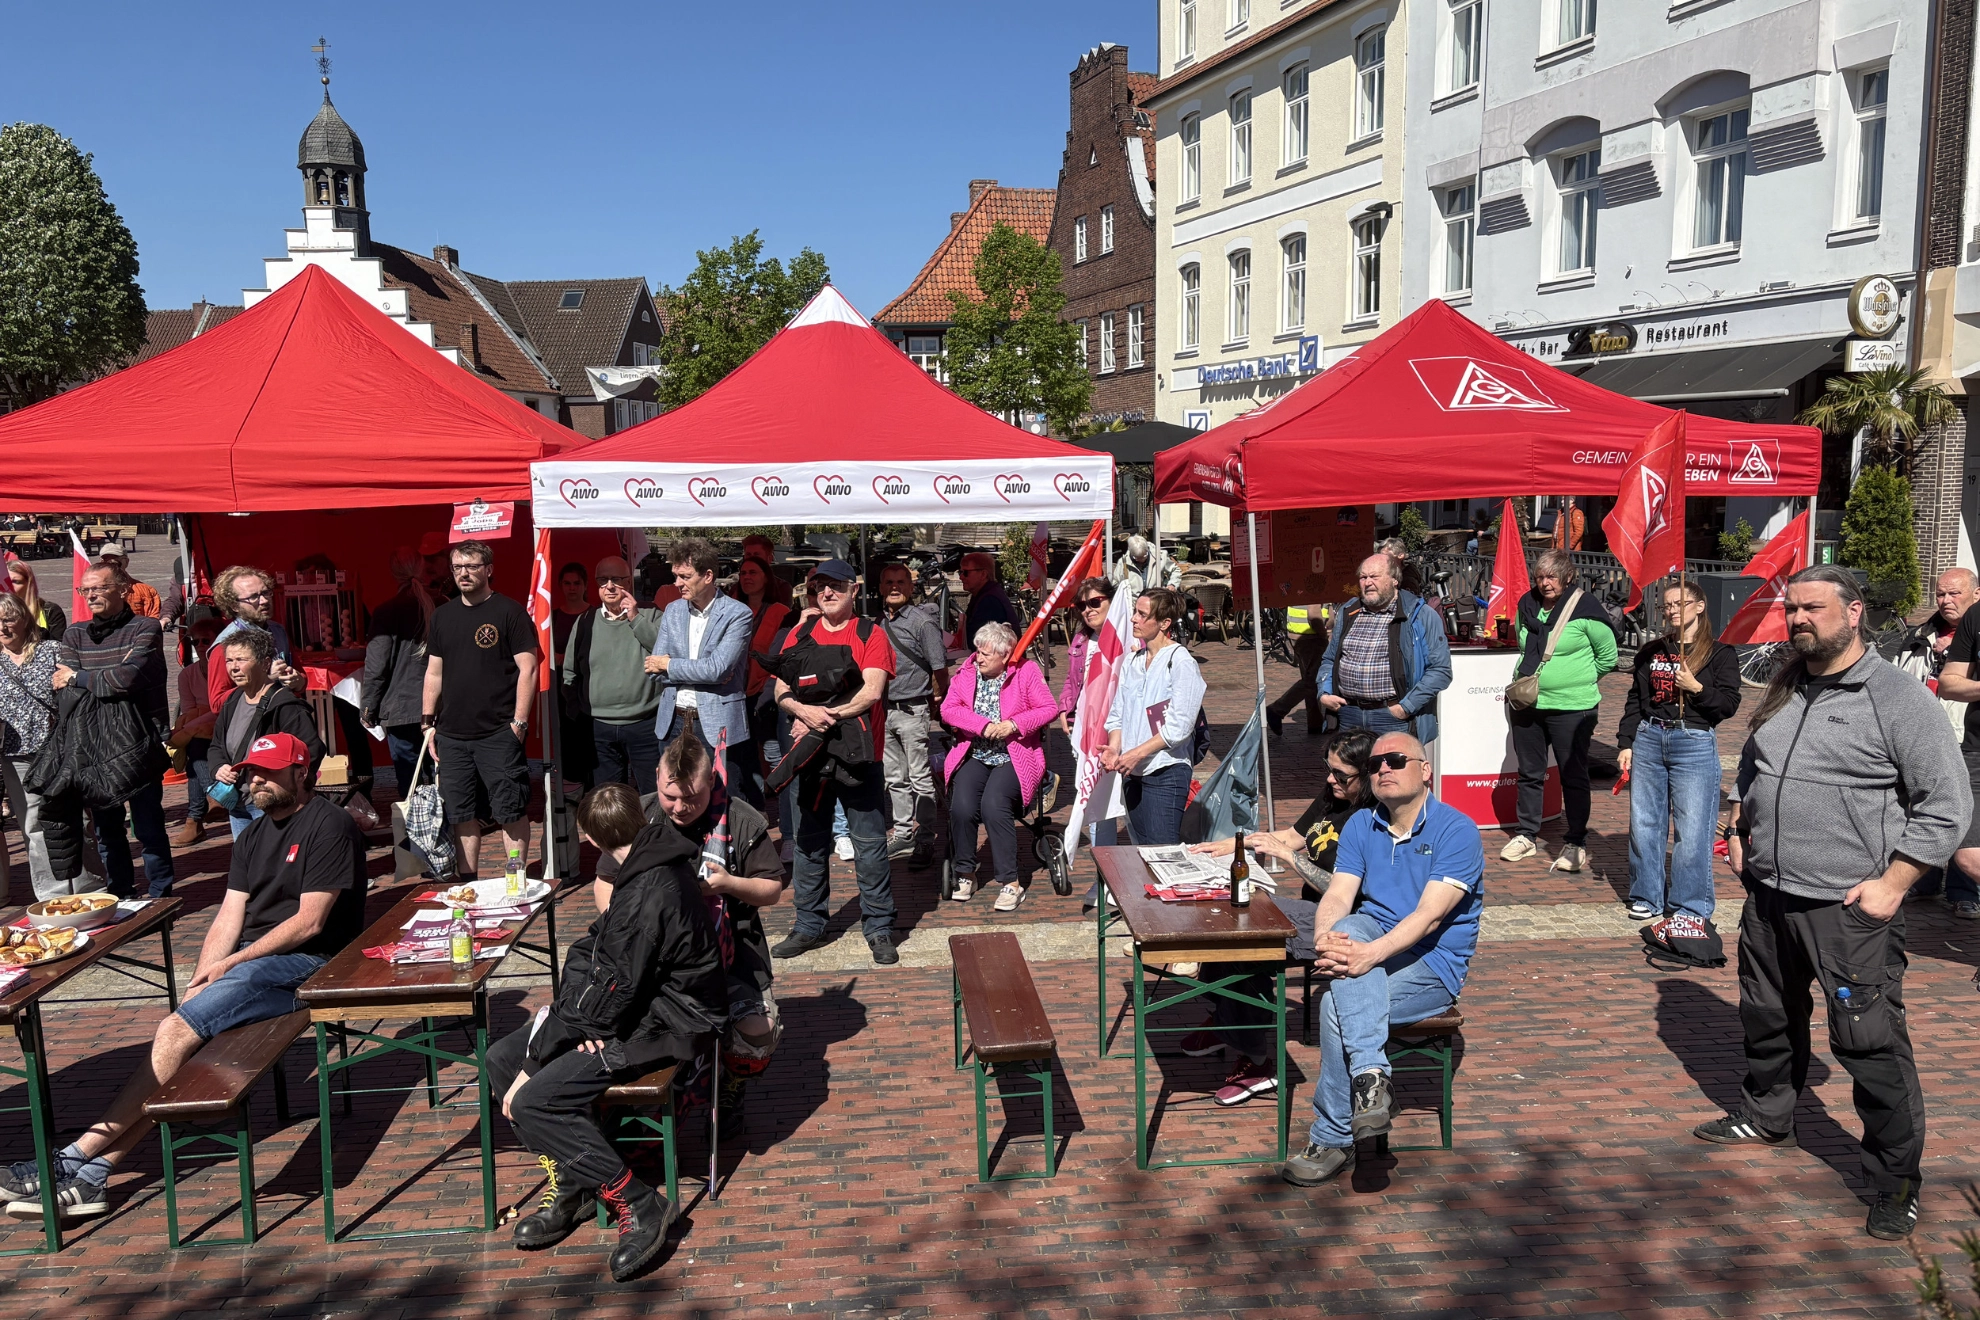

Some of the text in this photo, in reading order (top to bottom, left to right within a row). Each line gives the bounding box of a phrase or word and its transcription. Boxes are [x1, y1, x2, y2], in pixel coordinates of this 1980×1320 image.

[1540, 341, 1559, 356] Bar
[1647, 320, 1729, 344] Restaurant
[1198, 354, 1297, 384] Deutsche Bank
[1572, 450, 1632, 464] GEMEIN
[1699, 453, 1722, 466] EIN
[636, 487, 664, 498] AWO
[699, 486, 727, 497] AWO
[762, 485, 790, 497] AWO
[824, 484, 852, 496] AWO
[883, 484, 911, 495] AWO
[944, 481, 971, 495] AWO
[1004, 480, 1031, 494] AWO
[1064, 479, 1090, 493] AWO
[571, 489, 599, 499] AWO
